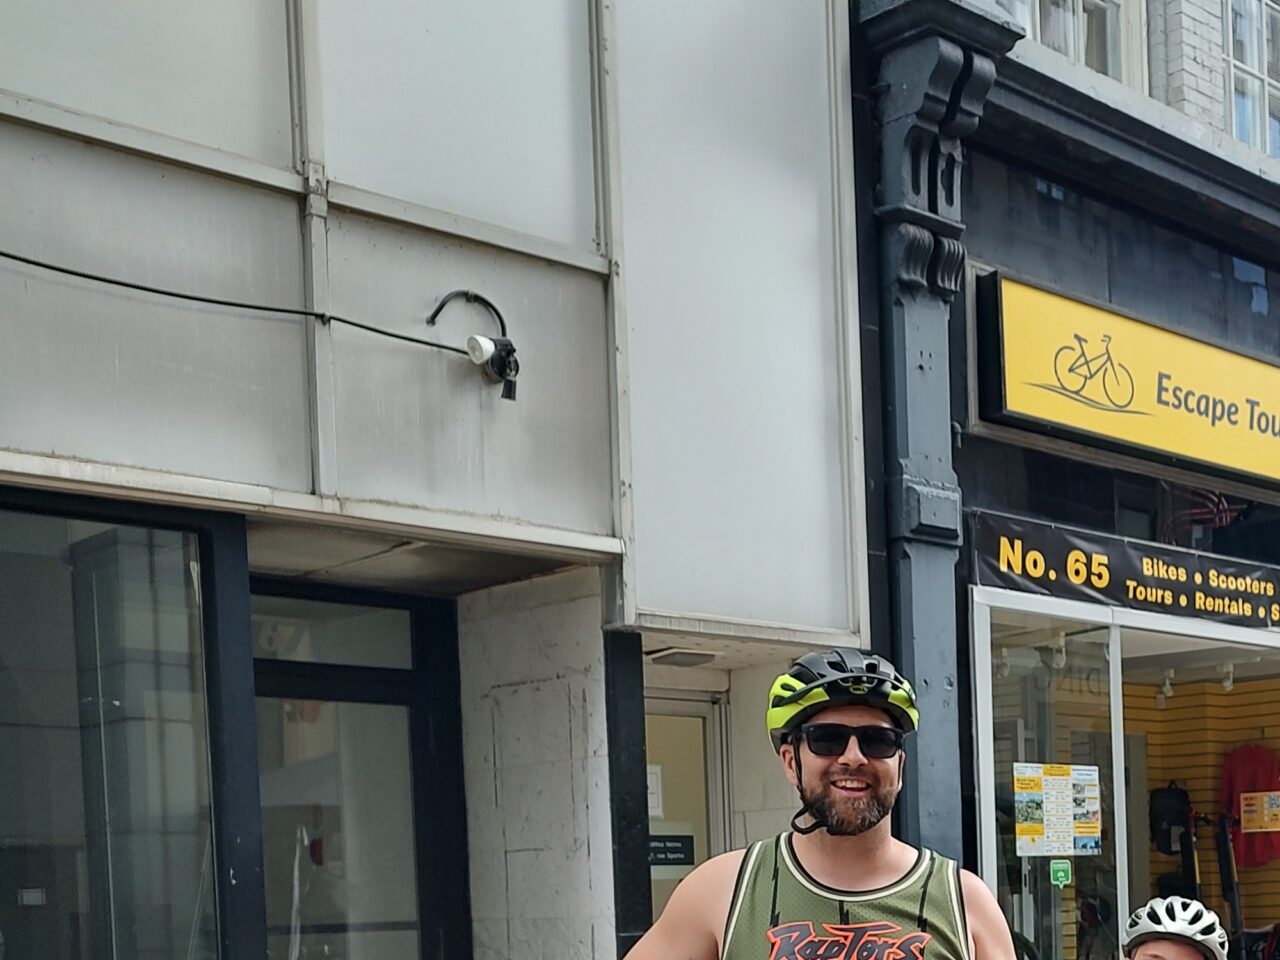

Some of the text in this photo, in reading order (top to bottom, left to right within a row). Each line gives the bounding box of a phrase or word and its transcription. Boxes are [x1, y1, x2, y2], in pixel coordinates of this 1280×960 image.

[1156, 372, 1239, 426] Escape
[999, 537, 1110, 588] No. 65
[1143, 556, 1187, 582] Bikes
[1209, 570, 1275, 596] Scooters
[1126, 580, 1173, 605] Tours
[1195, 591, 1253, 618] Rentals
